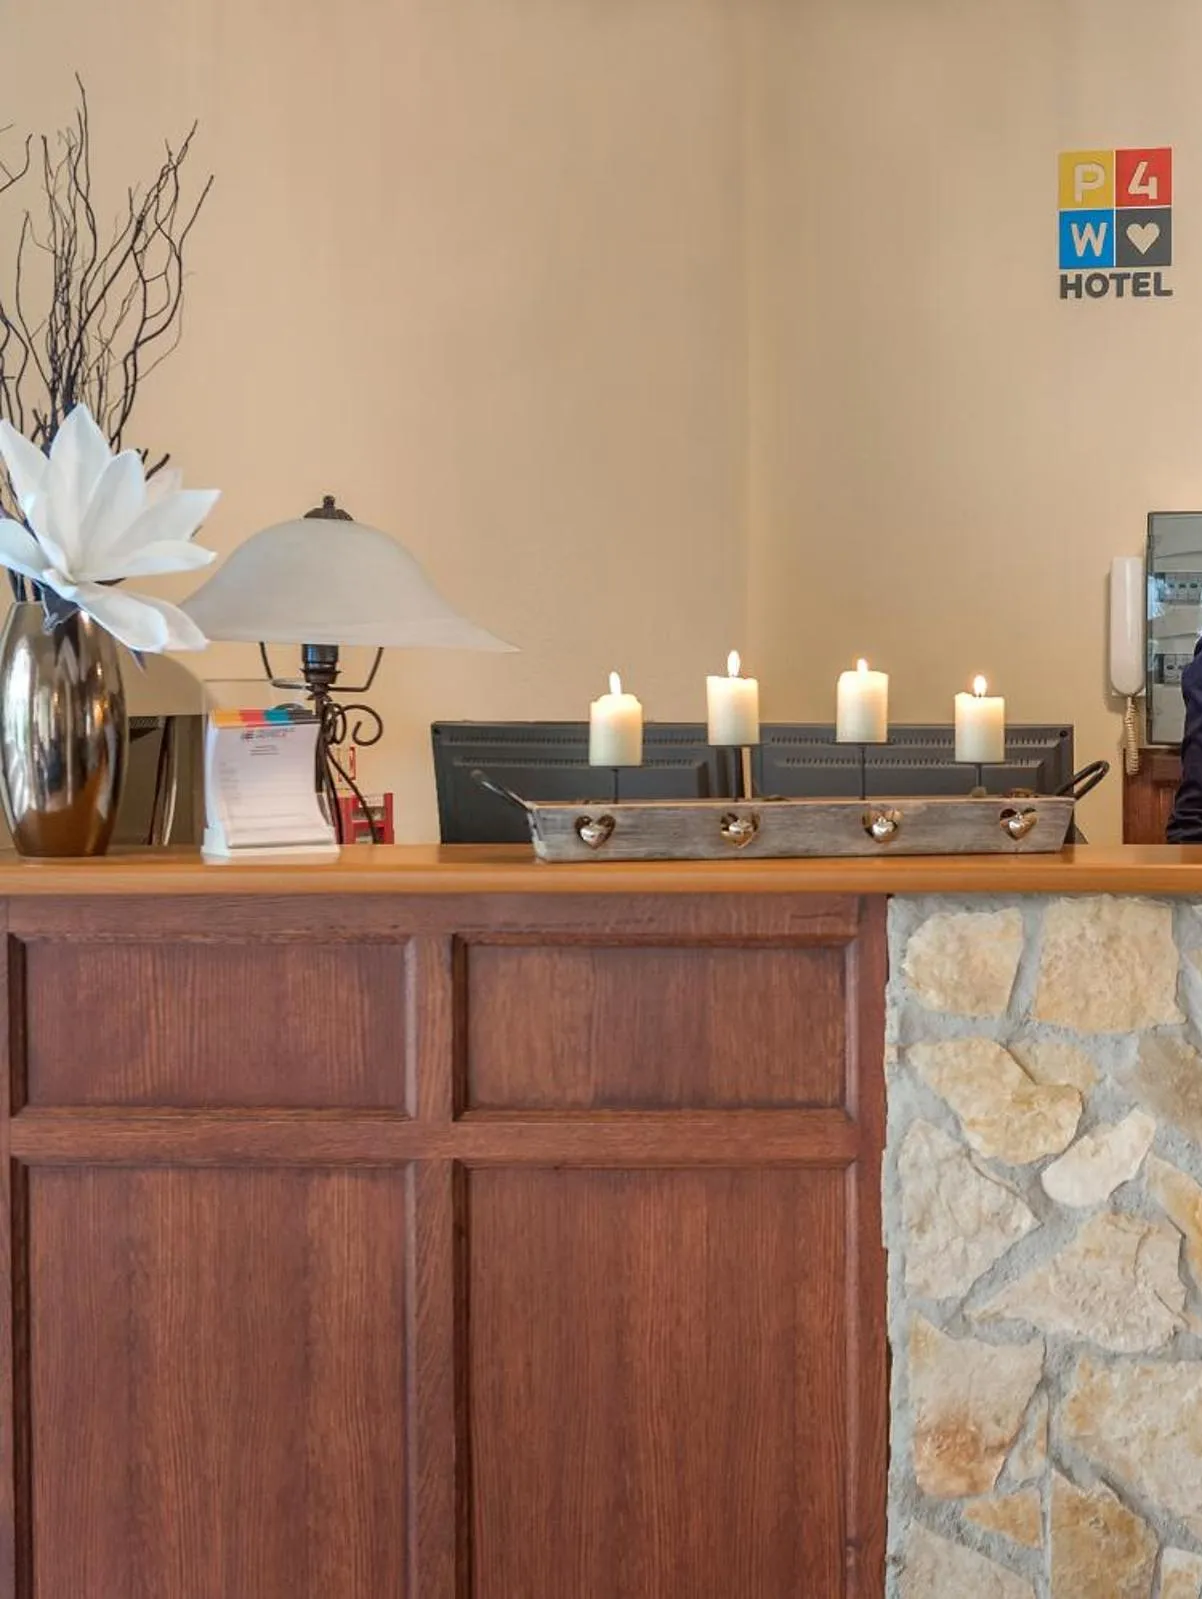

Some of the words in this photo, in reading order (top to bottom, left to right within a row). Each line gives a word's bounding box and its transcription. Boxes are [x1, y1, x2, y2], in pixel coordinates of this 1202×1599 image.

[1073, 162, 1106, 203] P
[1127, 160, 1158, 200] 4
[1069, 221, 1108, 258] W
[1060, 270, 1173, 299] HOTEL
